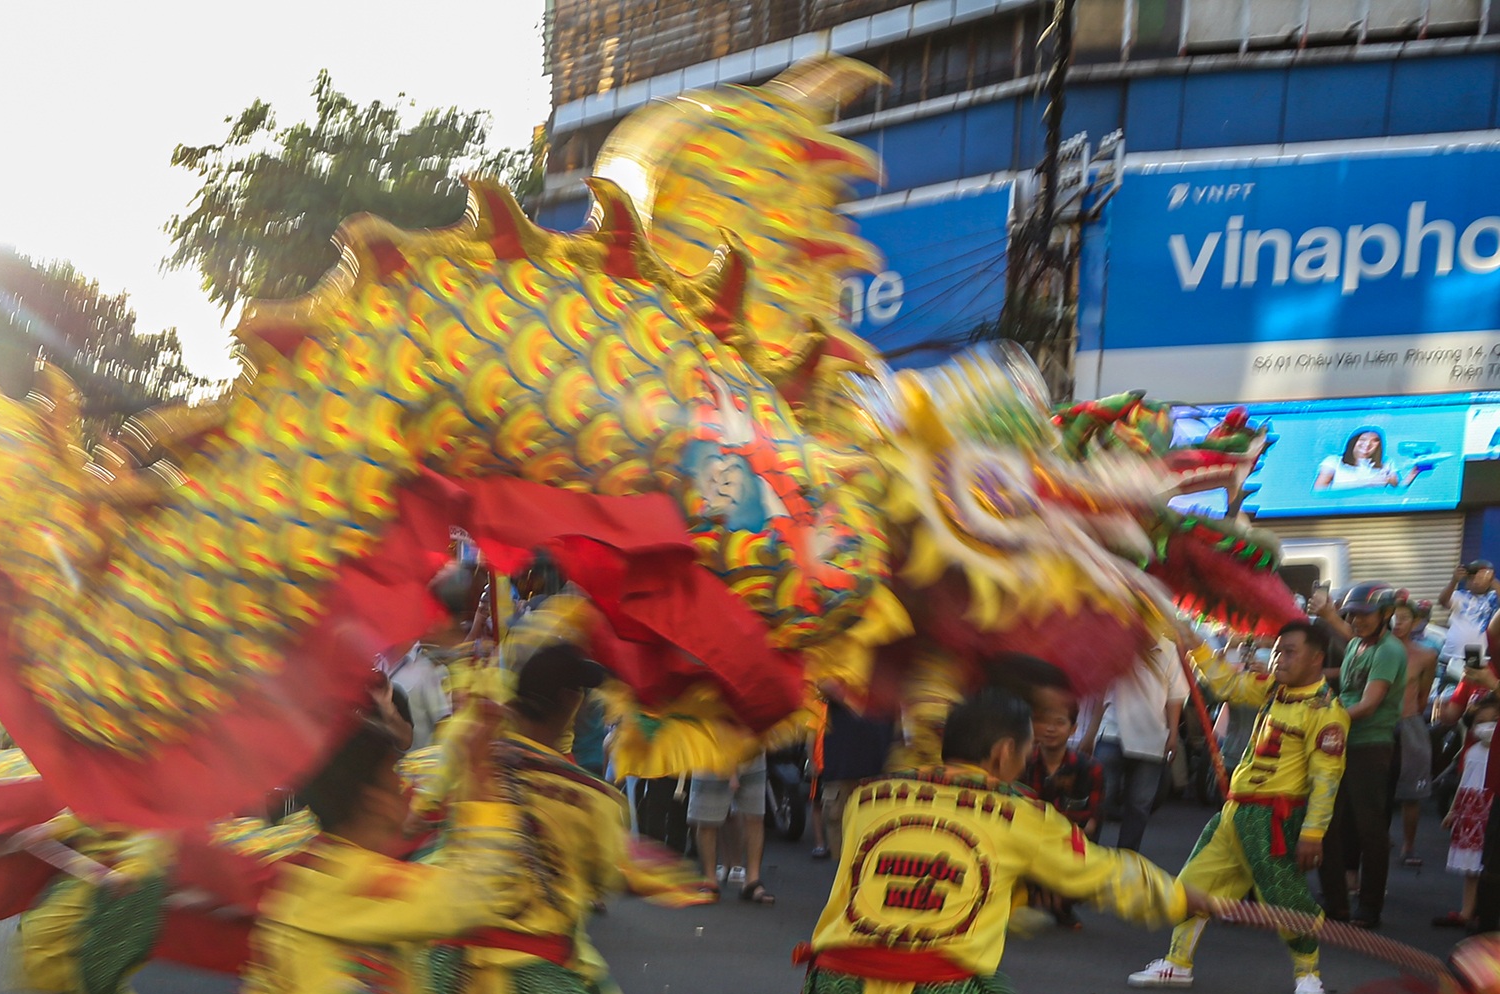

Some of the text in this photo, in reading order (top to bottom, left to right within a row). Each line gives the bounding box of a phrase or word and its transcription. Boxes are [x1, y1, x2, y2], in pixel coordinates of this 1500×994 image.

[1195, 182, 1255, 205] VNPT
[1254, 353, 1273, 371] Số
[1275, 355, 1291, 371] 01
[1295, 352, 1330, 370] Châu
[1335, 351, 1361, 367] Văn
[1365, 350, 1398, 366] Liêm
[1404, 346, 1462, 365] Phường
[1450, 363, 1484, 382] Điện
